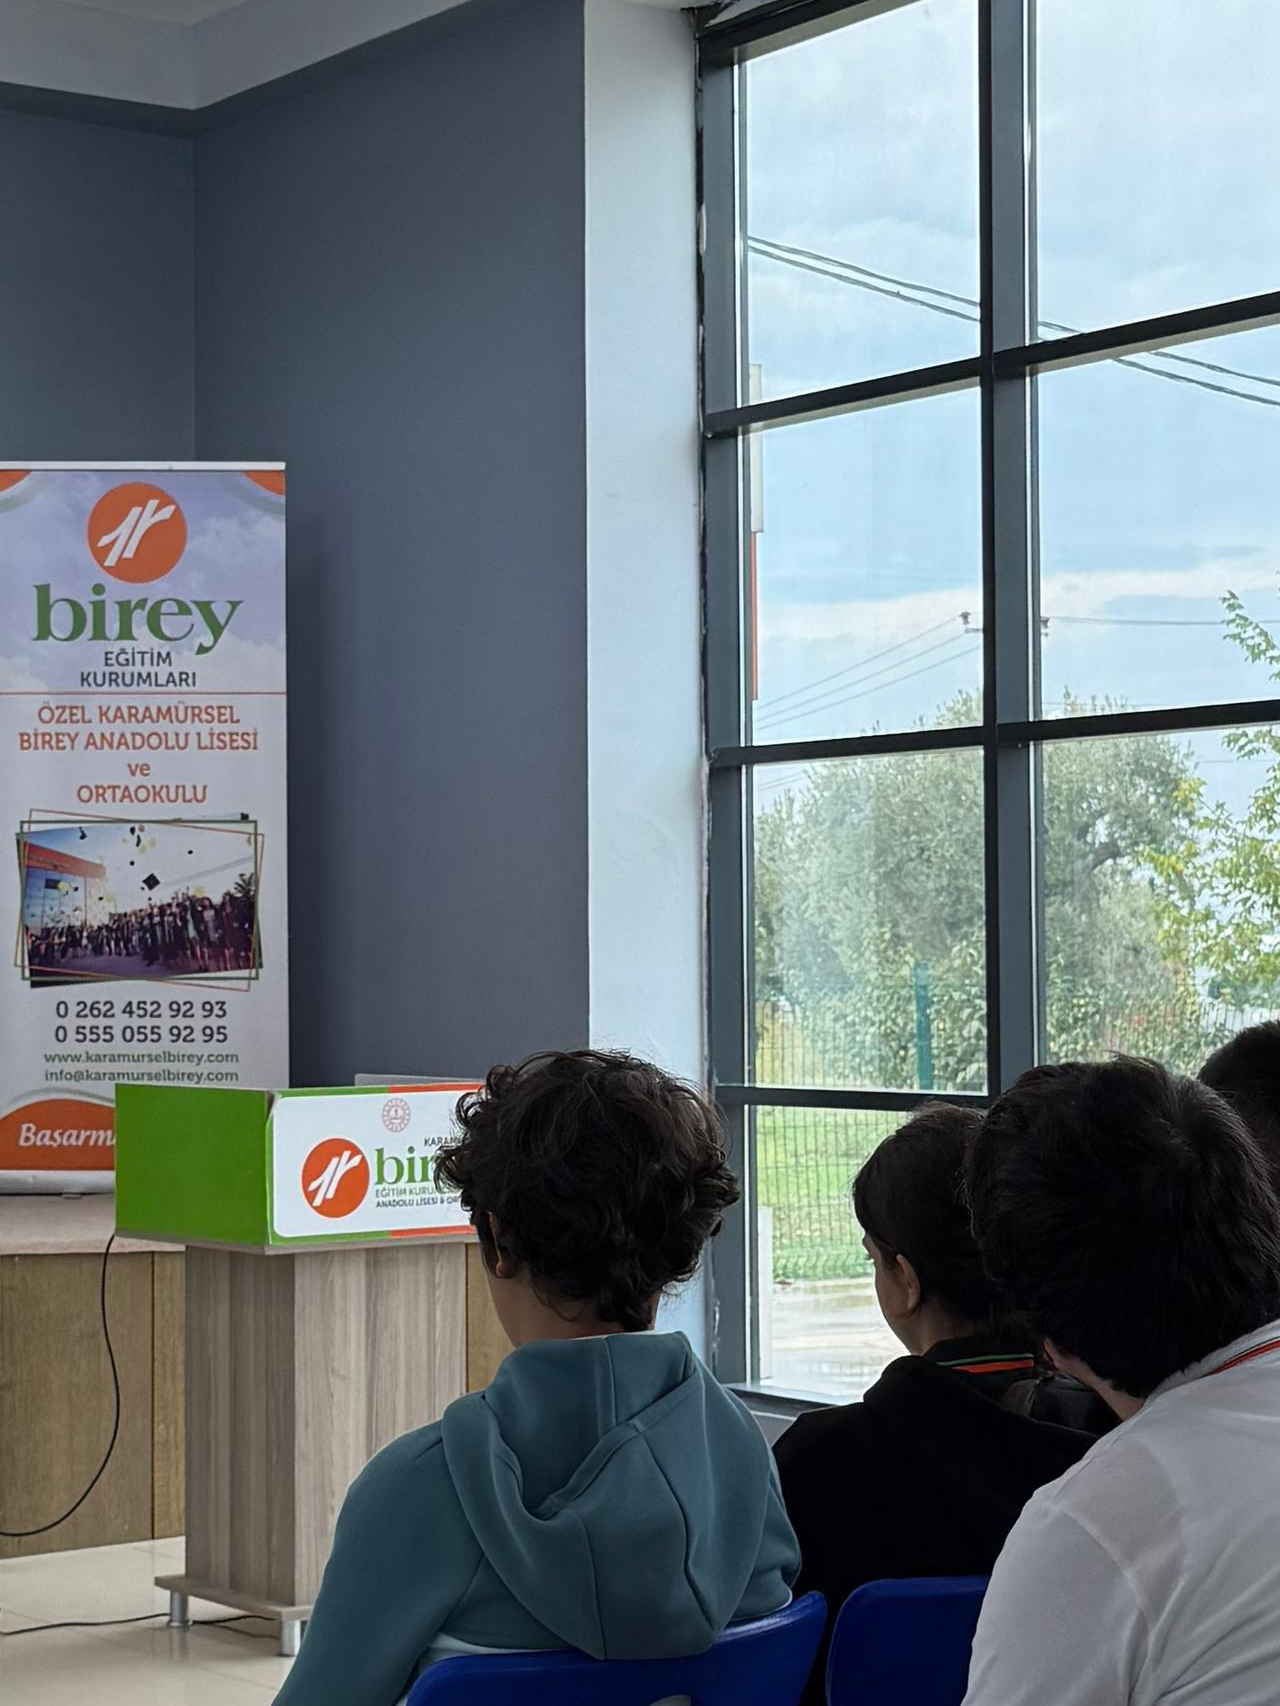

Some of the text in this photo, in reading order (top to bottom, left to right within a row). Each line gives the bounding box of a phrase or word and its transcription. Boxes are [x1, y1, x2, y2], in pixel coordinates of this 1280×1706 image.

[32, 583, 244, 655] birey
[104, 647, 172, 667] EĞİTİM
[80, 671, 196, 688] KURUMLARI
[38, 701, 240, 724] ÖZEL KARAMÜRSEL
[19, 728, 258, 751] BİREY ANADOLU LİSESİ
[127, 763, 151, 777] ve
[76, 784, 208, 804] ORTAOKULU
[55, 1000, 228, 1019] 0 262 452 92 93
[54, 1025, 229, 1044] 0 555 055 92 95
[44, 1051, 239, 1066] www.karamurselbirey.com
[45, 1068, 239, 1085] info@karamurselbirey.com
[19, 1122, 116, 1148] Başarm
[375, 1146, 436, 1185] bir
